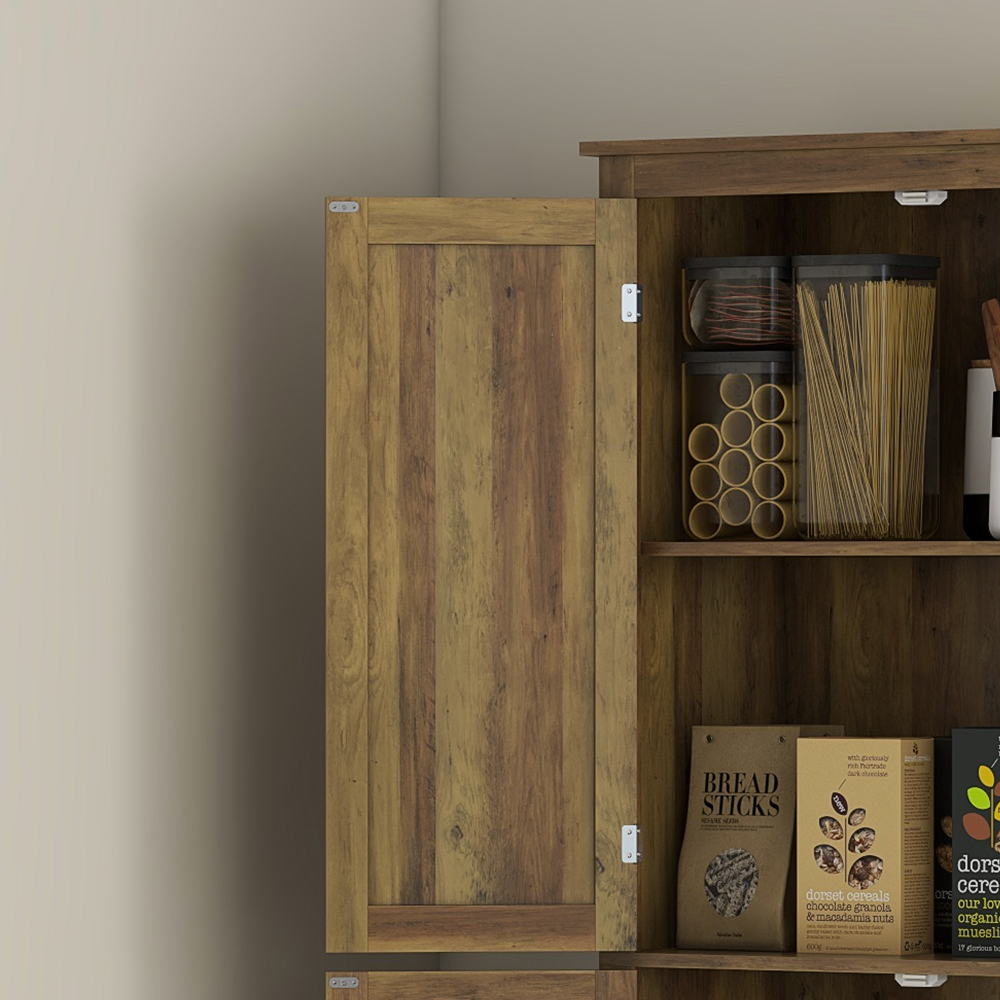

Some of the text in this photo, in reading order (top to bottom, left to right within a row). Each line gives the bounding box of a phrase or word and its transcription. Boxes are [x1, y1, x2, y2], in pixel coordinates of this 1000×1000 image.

[702, 772, 779, 794] BREAD
[701, 794, 780, 817] STICKS
[832, 795, 846, 813] new
[806, 889, 890, 902] dorset cereals
[806, 901, 892, 914] chocolate granola
[957, 899, 980, 909] our
[806, 911, 895, 924] & macadamia nuts
[957, 927, 1000, 938] muesli
[806, 943, 822, 952] 600g
[966, 944, 992, 952] glorious
